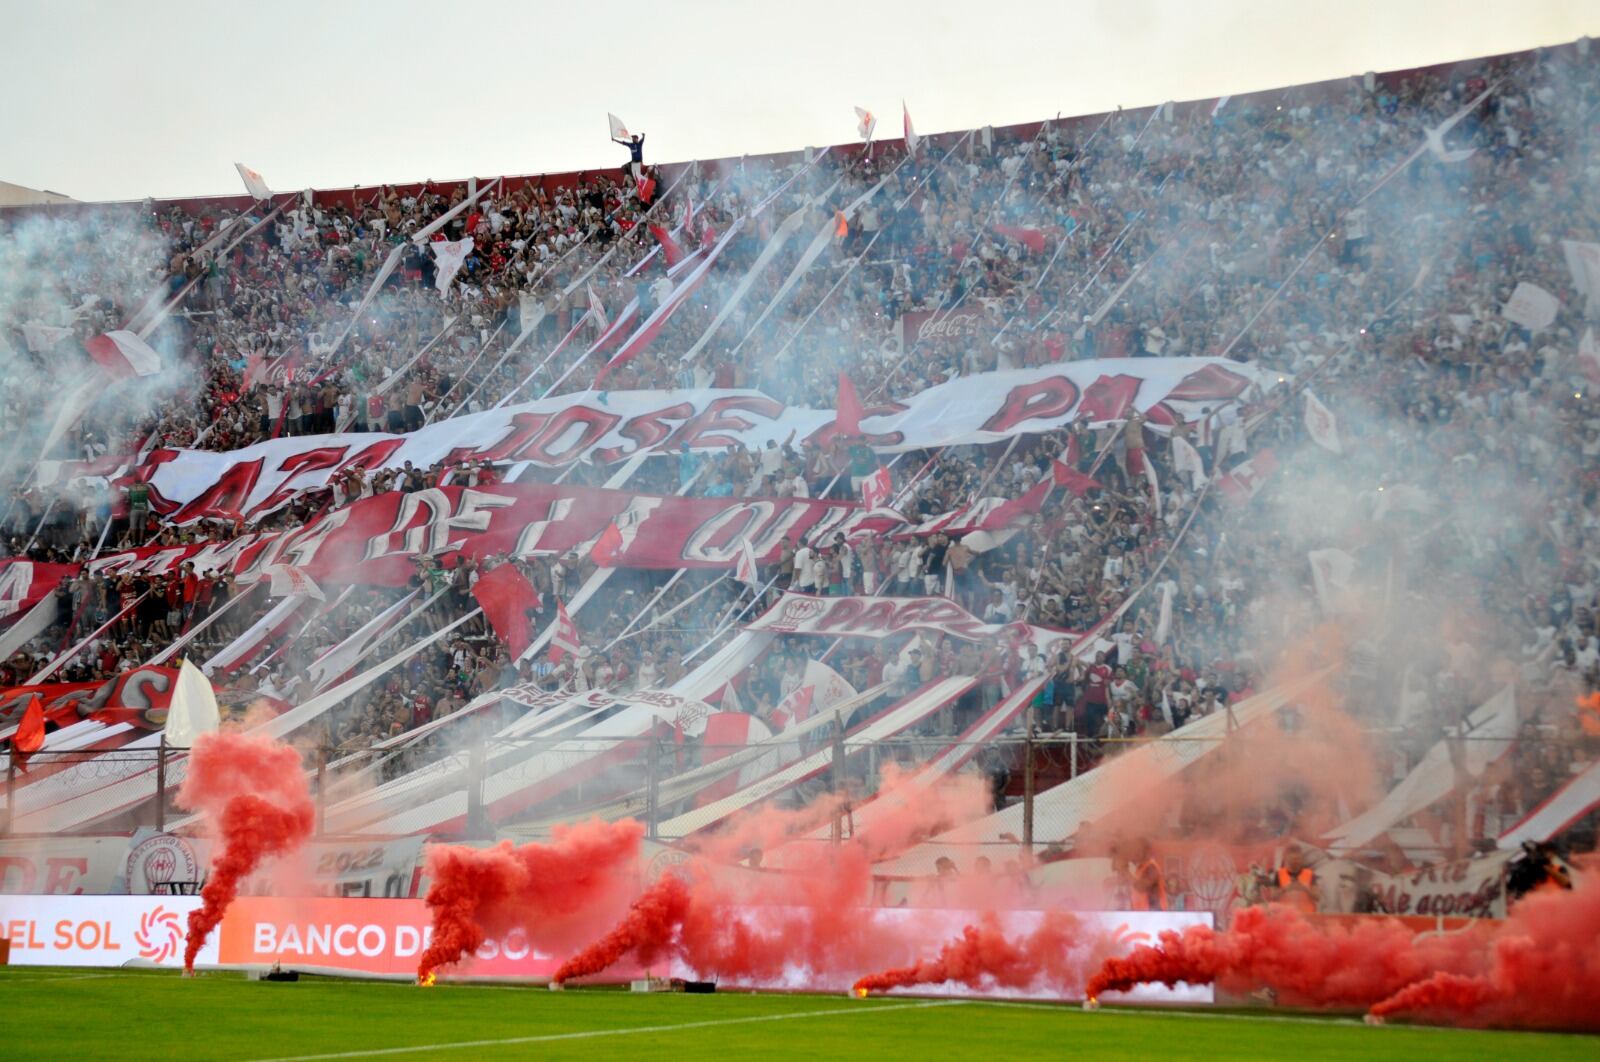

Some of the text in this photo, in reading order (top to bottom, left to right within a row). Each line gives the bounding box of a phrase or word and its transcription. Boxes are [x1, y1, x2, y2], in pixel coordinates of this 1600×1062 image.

[443, 394, 786, 466] JOSE
[361, 488, 517, 562] DE
[317, 847, 385, 874] 2022
[0, 919, 121, 950] EL SOL
[253, 922, 386, 957] BANCO
